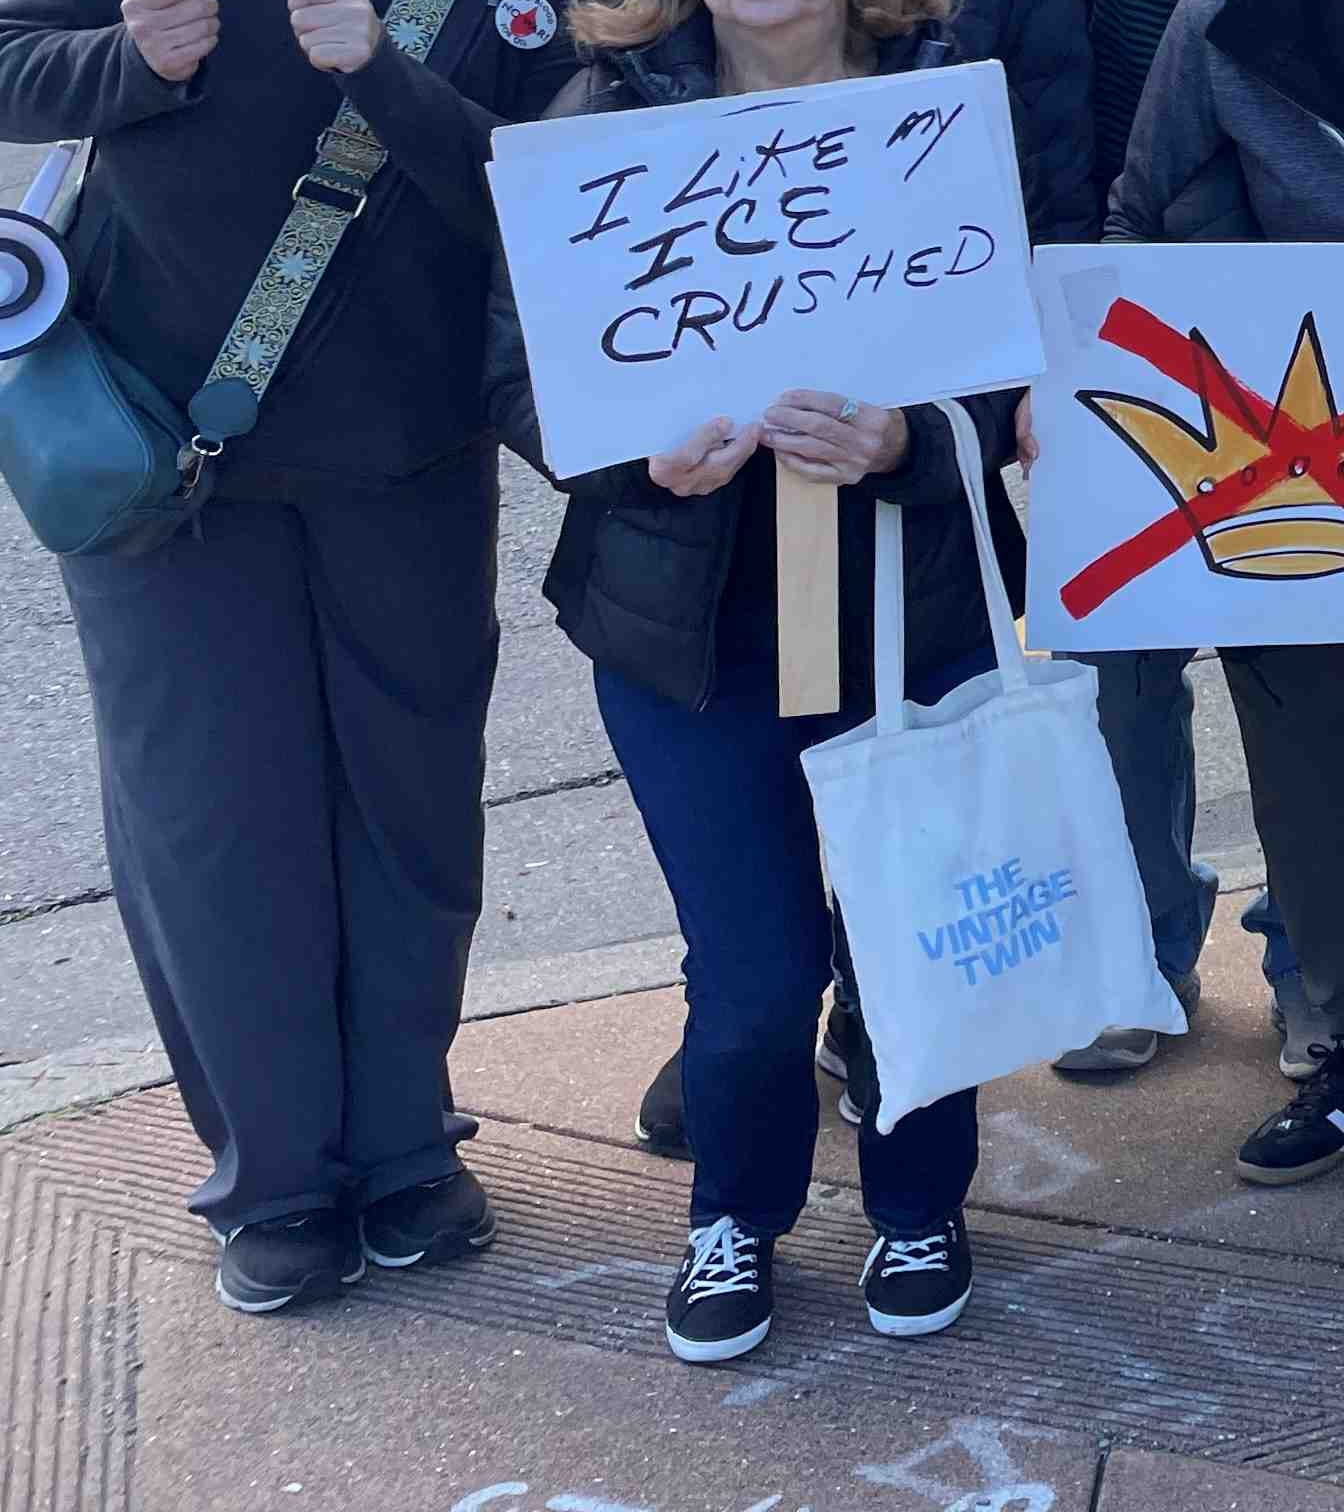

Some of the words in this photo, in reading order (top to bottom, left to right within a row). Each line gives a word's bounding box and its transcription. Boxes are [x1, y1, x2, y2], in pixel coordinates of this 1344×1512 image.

[568, 165, 648, 244] I
[624, 185, 857, 290] ICE
[601, 224, 996, 363] CRUSHED
[917, 868, 1078, 961] VINTAGE
[954, 857, 1026, 912] THE
[954, 911, 1061, 986] TWIN
